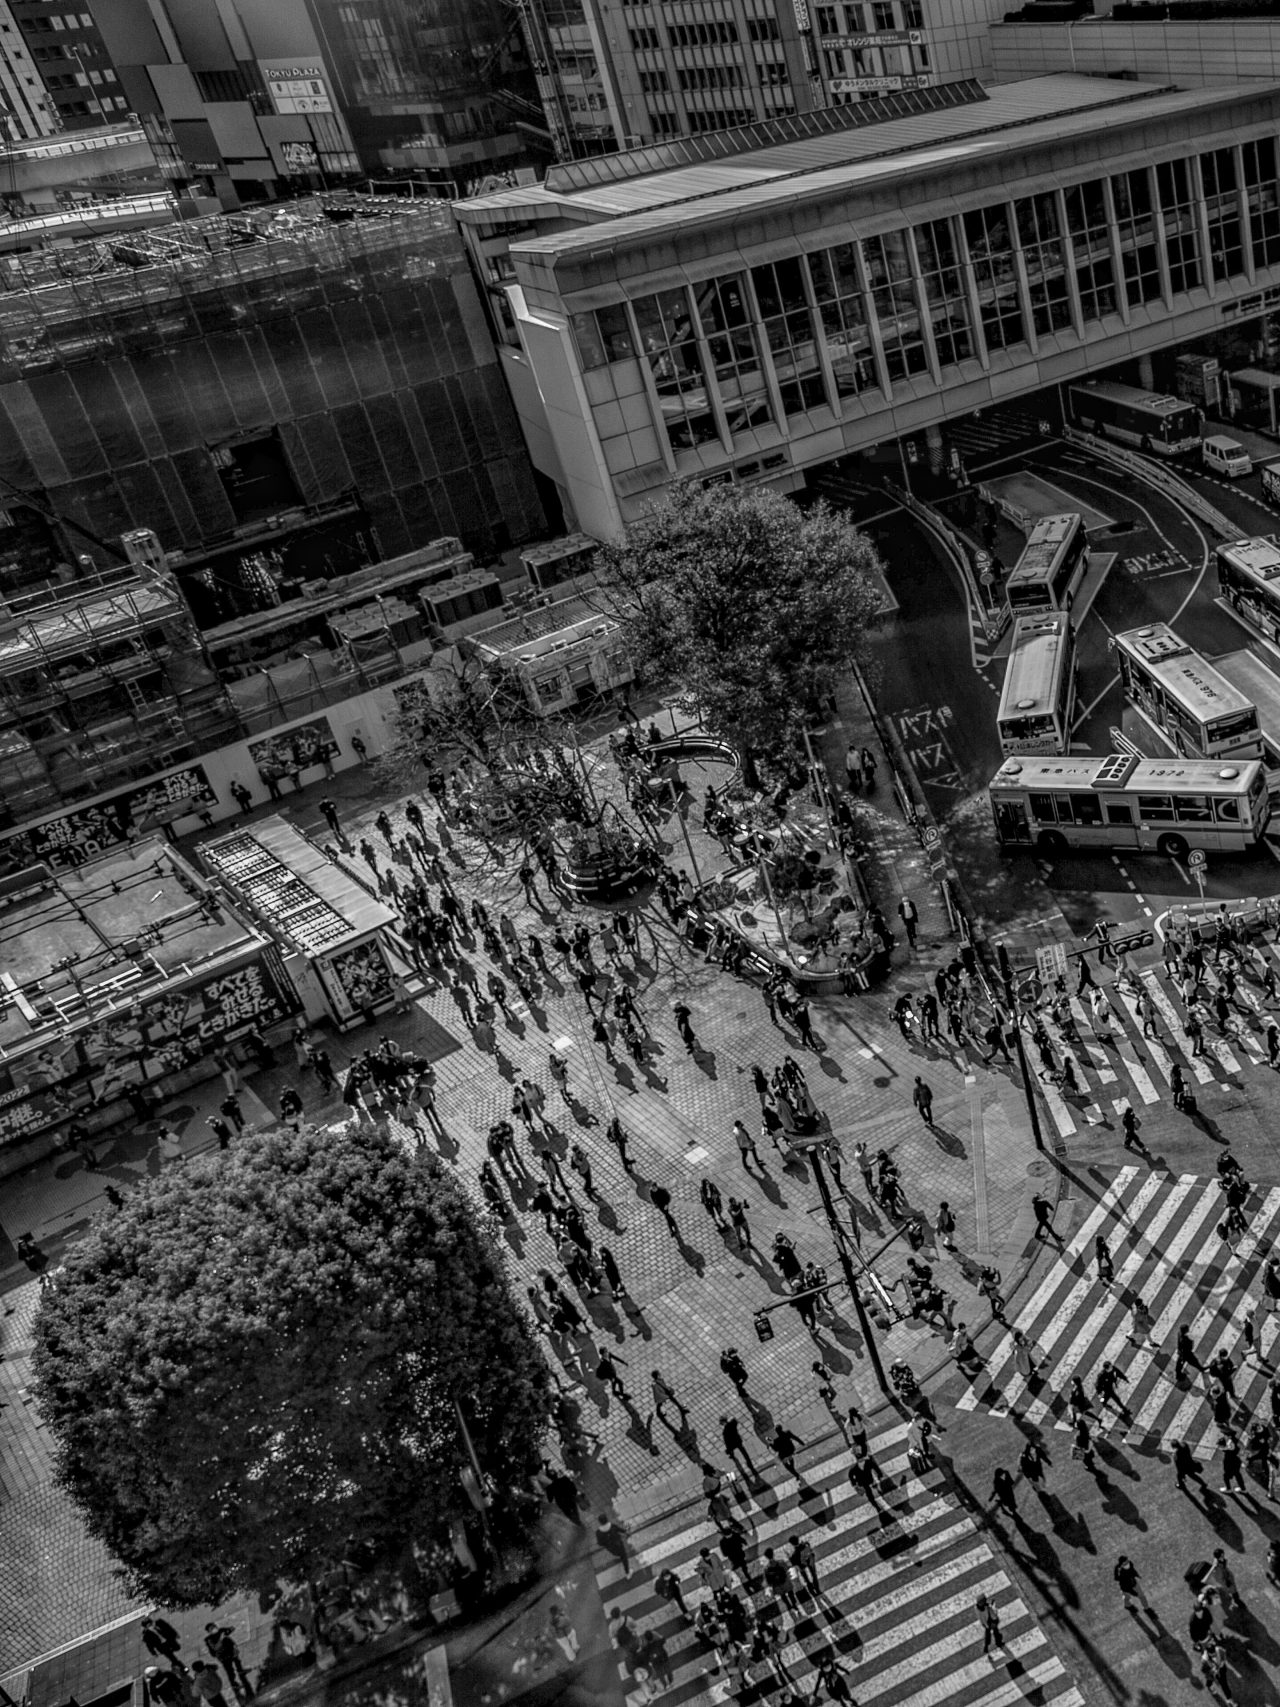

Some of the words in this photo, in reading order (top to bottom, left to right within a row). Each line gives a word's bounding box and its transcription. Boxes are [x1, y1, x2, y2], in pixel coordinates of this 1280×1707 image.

[265, 69, 291, 78] TOKYU
[292, 68, 321, 76] PLAZA
[205, 965, 260, 999] すべてを
[219, 984, 264, 1011] みせる
[198, 998, 277, 1039] ときがきた。
